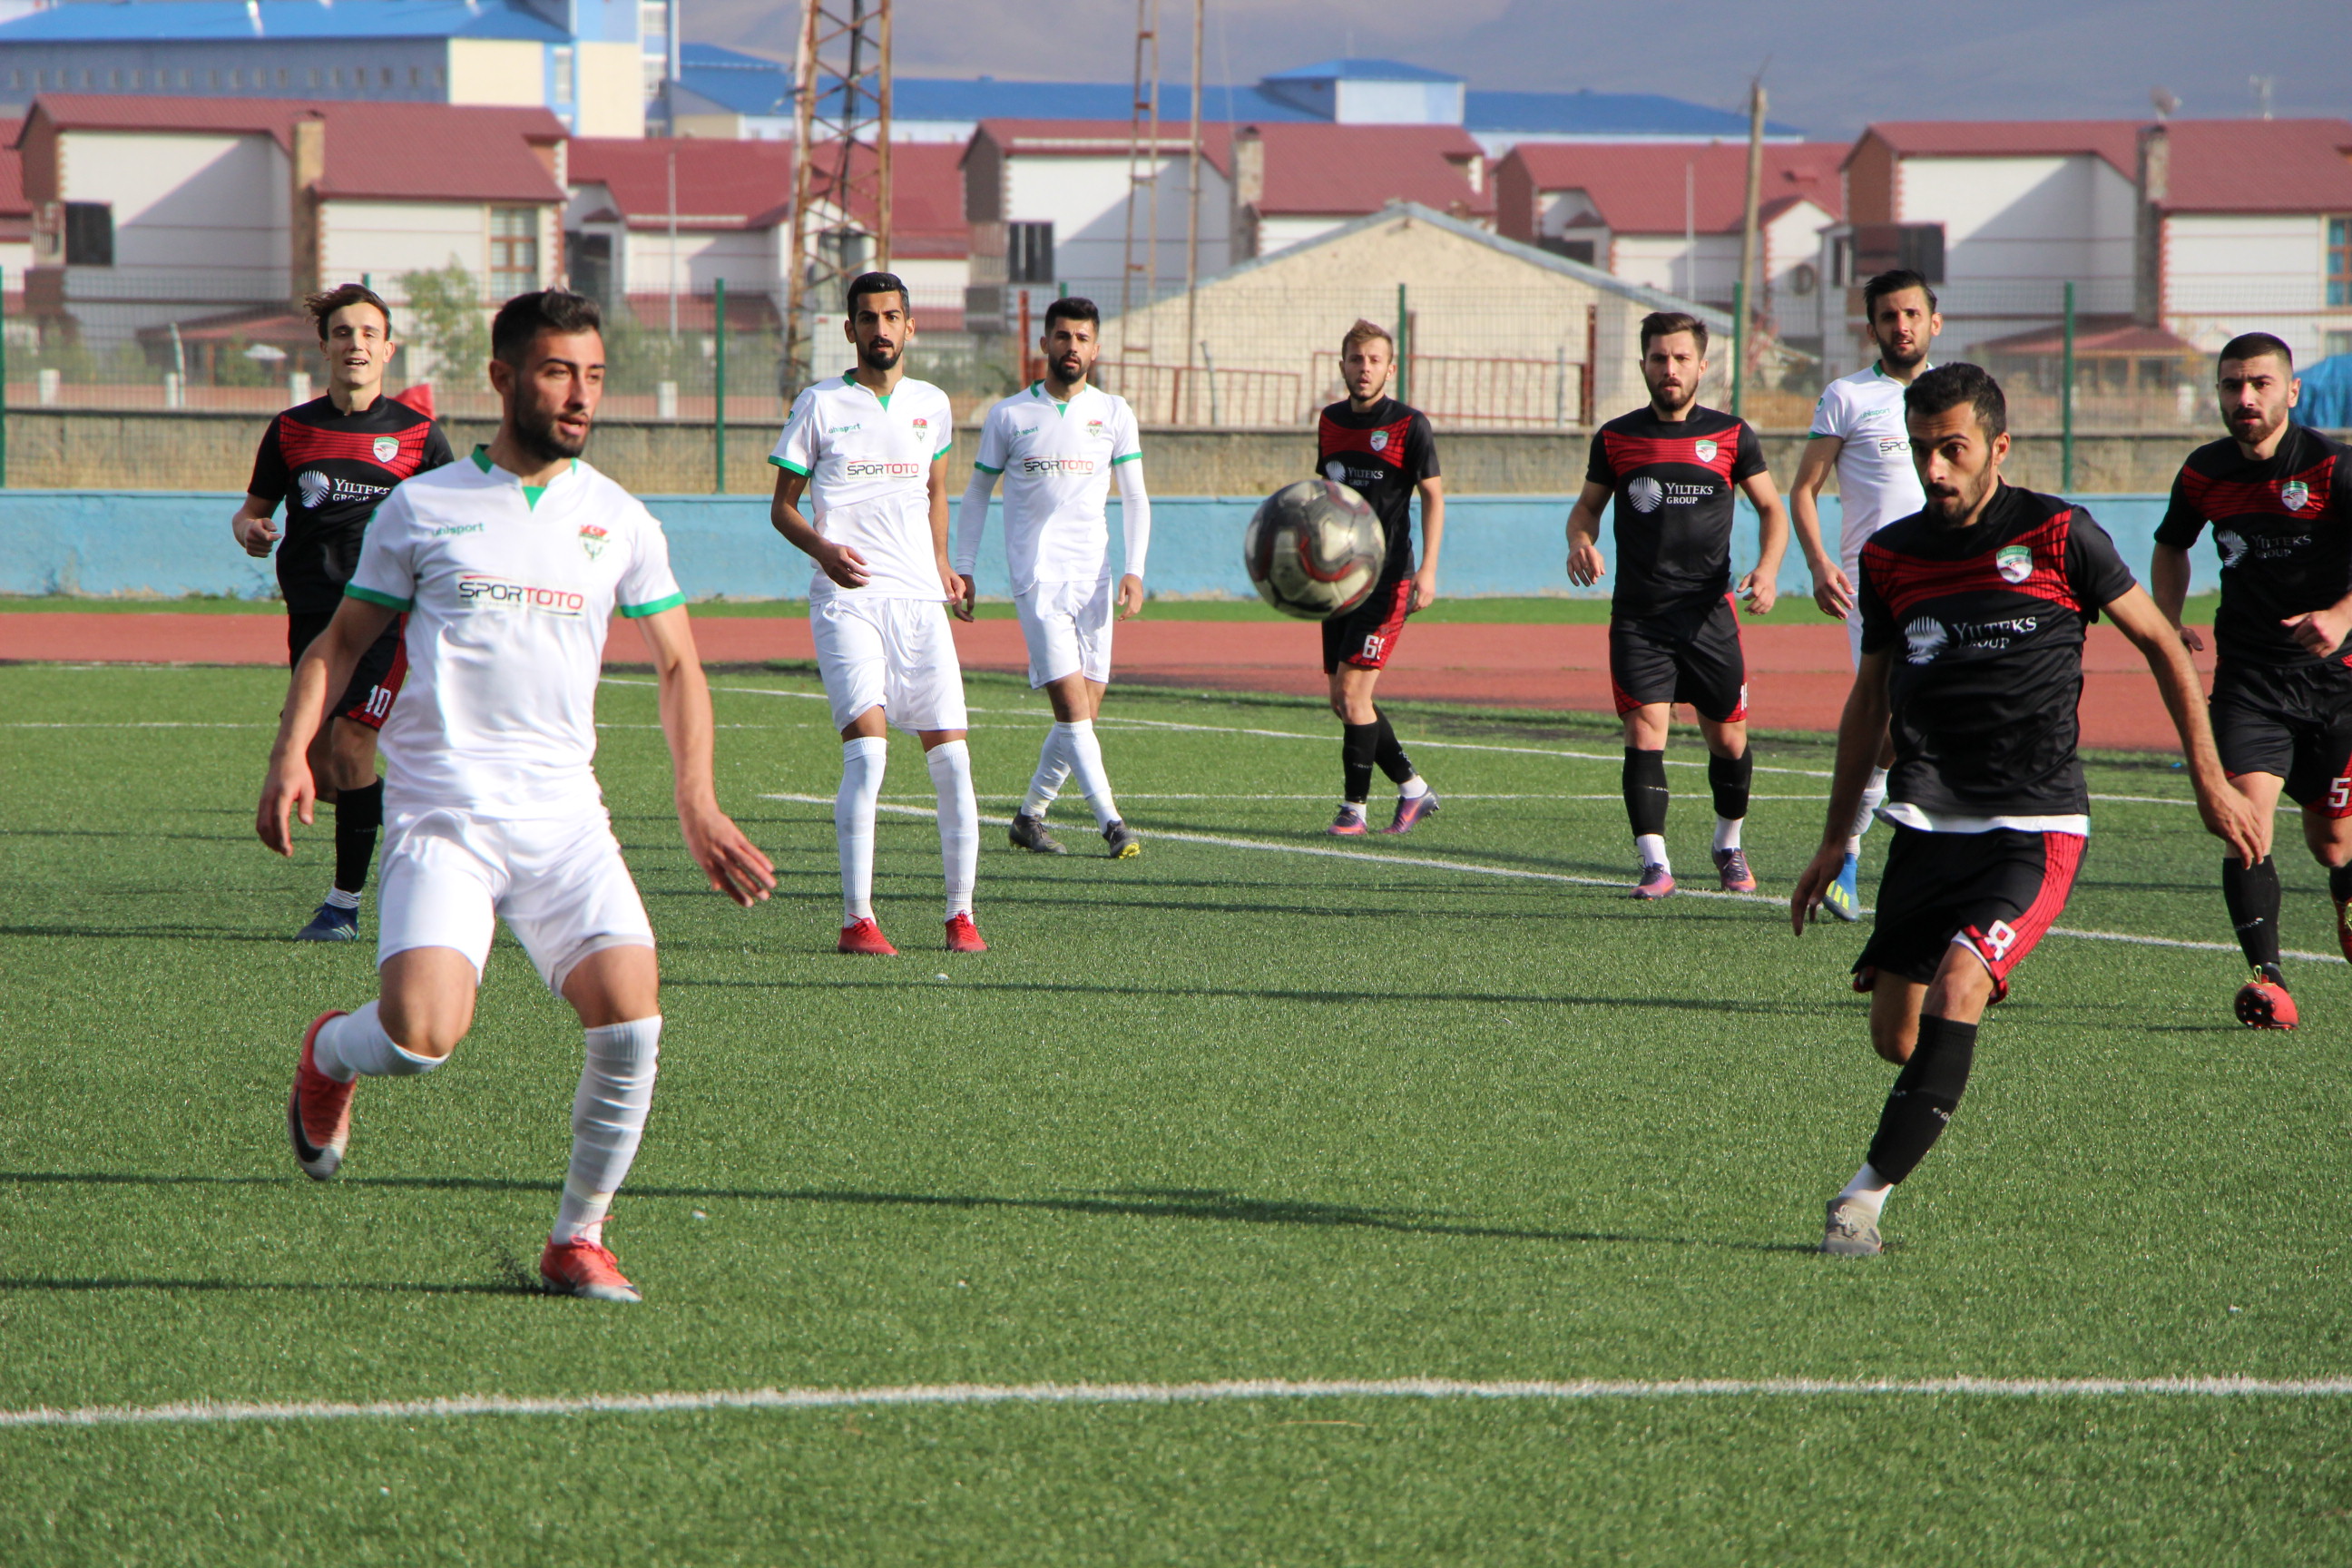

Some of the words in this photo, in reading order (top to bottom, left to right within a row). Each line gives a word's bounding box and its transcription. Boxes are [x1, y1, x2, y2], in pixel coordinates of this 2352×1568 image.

[1879, 441, 1910, 452] SPO
[847, 463, 919, 475] SPORTOTO
[1024, 460, 1094, 472] SPORTOTO
[1348, 467, 1384, 479] YILTEKS
[334, 477, 391, 495] YILTEKS
[1665, 482, 1714, 495] YILTEKS
[1666, 496, 1699, 505] GROUP
[432, 523, 485, 537] uhlsport
[459, 582, 583, 610] SPORTOTO
[365, 684, 392, 719] 10
[2328, 777, 2352, 808] 5
